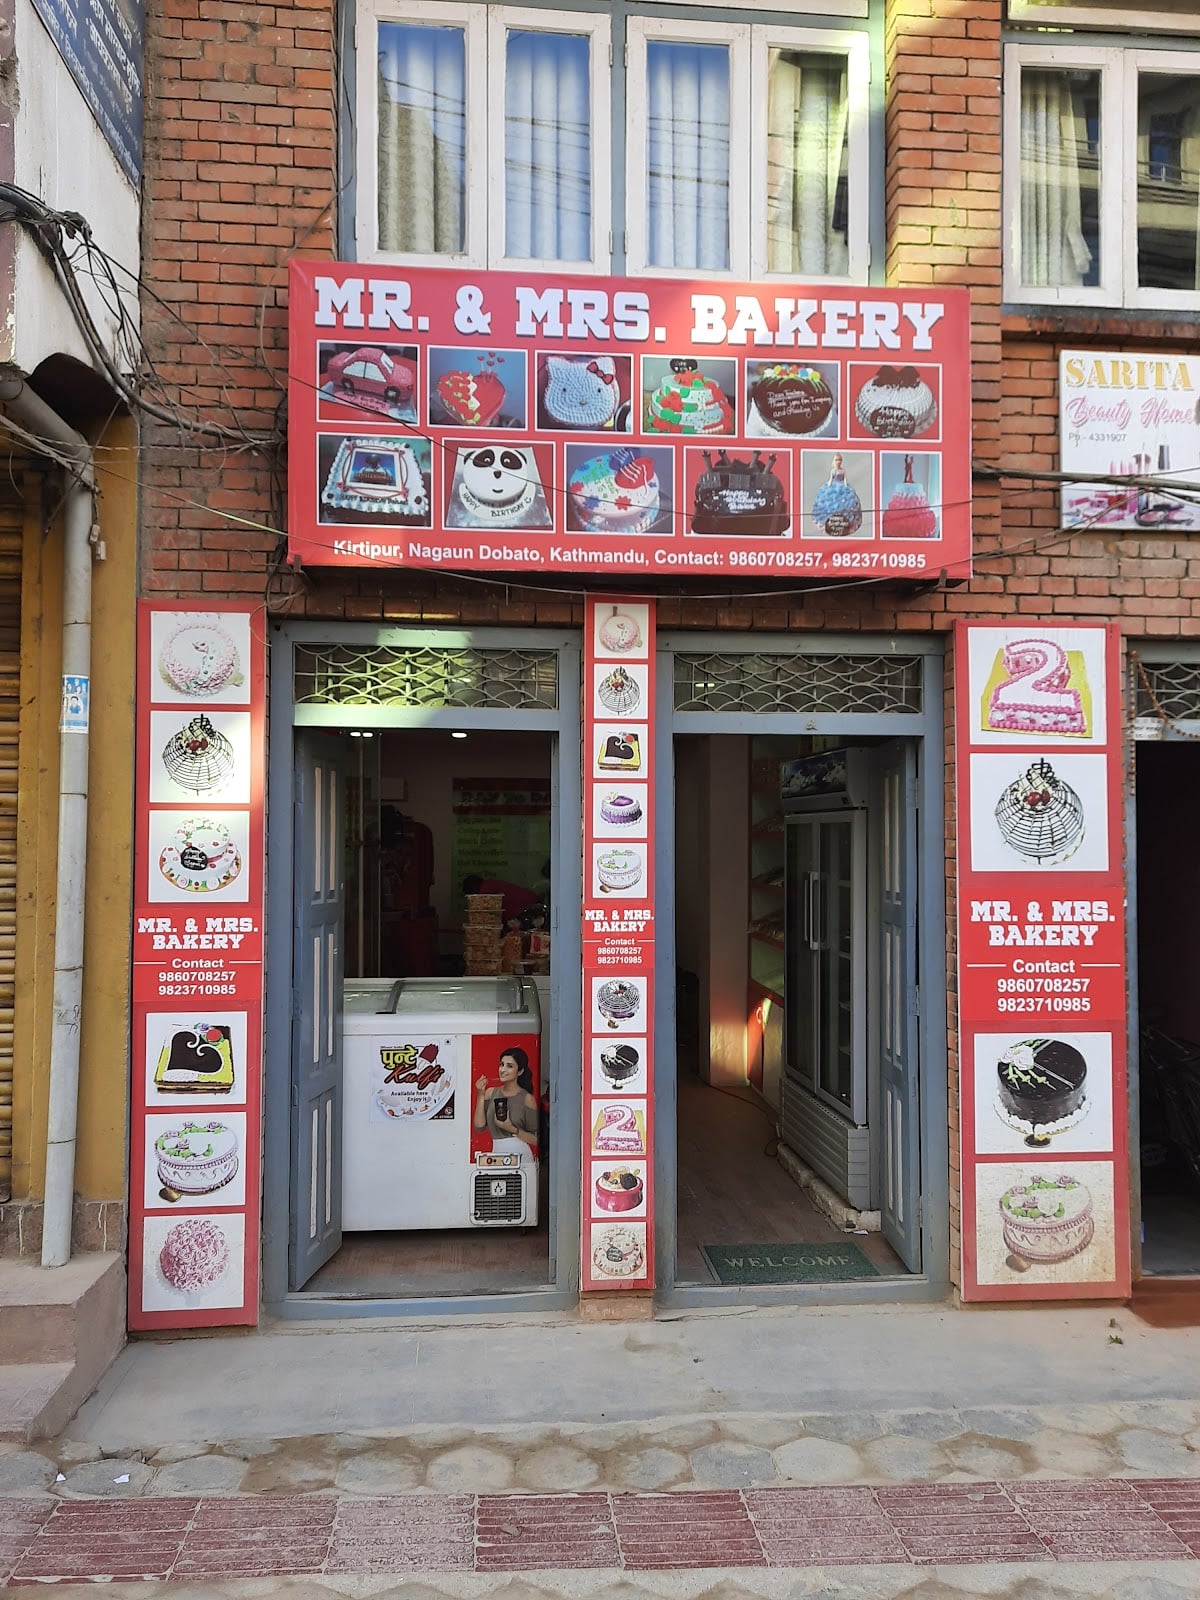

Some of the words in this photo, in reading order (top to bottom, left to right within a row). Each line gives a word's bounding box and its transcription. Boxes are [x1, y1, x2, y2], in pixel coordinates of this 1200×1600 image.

[314, 276, 430, 332] MR.
[453, 285, 493, 336] &
[514, 286, 668, 342] MRS.
[689, 295, 946, 350] BAKERY
[1065, 357, 1195, 391] SARITA
[1065, 395, 1134, 430] Beauty
[1139, 396, 1194, 428] Home
[1088, 433, 1128, 442] 4331907
[490, 502, 524, 517] BIRTHDAY
[333, 540, 402, 560] Kirtipur,
[408, 543, 474, 562] Nagaun
[478, 545, 545, 564] Dobato,
[549, 547, 650, 566] Kathmandu,
[654, 549, 724, 567] Contact:
[729, 552, 828, 570] 9860708257,
[831, 552, 927, 569] 9823710985
[585, 909, 608, 921] MR.
[611, 910, 620, 921] &
[624, 909, 654, 921] MRS.
[970, 900, 1018, 922] MR.
[1027, 901, 1044, 922] &
[1052, 900, 1116, 922] MRS.
[138, 917, 177, 933] MR.
[185, 918, 199, 933] &
[205, 917, 259, 933] MRS.
[593, 921, 646, 932] BAKERY
[153, 934, 245, 950] BAKERY
[989, 925, 1099, 946] BAKERY
[597, 947, 642, 955] 9860708257
[172, 958, 224, 969] Contact
[597, 956, 642, 964] 9823710985
[1012, 959, 1075, 973] Contact
[158, 971, 236, 982] 9860708257
[158, 985, 236, 996] 9823710985
[997, 978, 1090, 993] 9860708257
[997, 997, 1091, 1012] 9823710985
[384, 1064, 445, 1090] Kulfi
[723, 1255, 855, 1270] WELCOME
